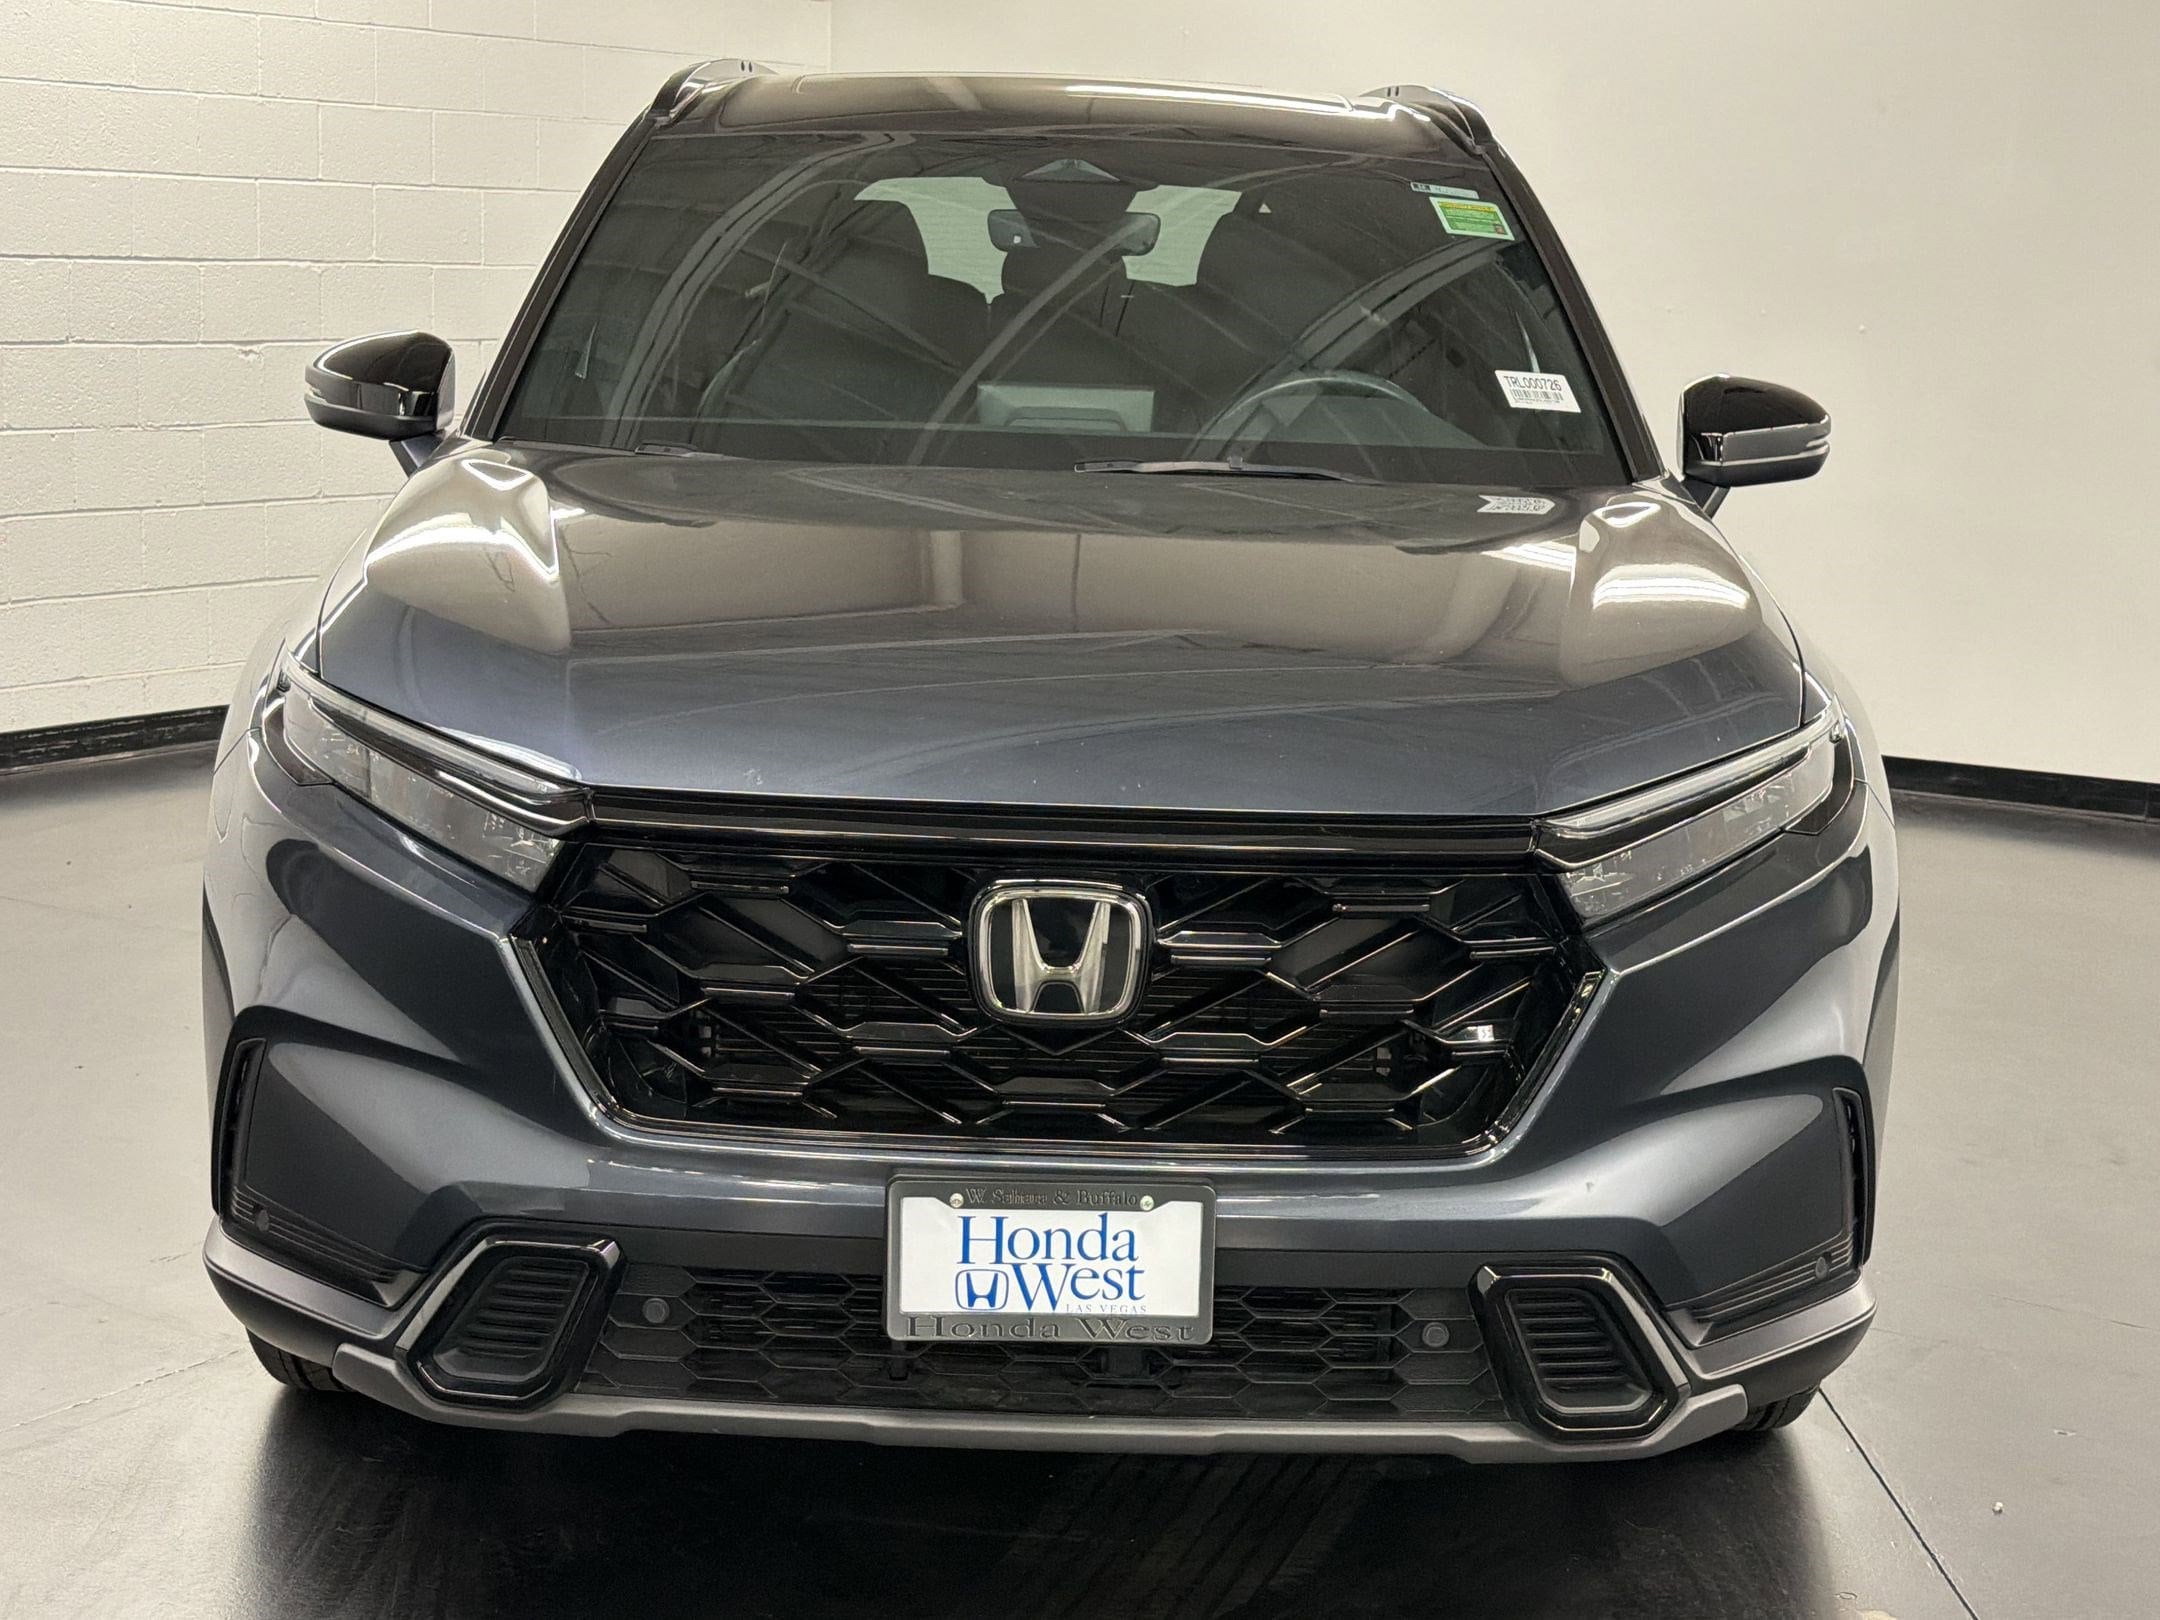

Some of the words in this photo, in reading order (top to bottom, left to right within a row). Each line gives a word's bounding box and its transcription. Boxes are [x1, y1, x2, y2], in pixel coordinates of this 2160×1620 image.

[1053, 1189, 1071, 1206] &
[957, 1212, 1138, 1264] Honda
[1012, 1262, 1145, 1312] West
[1066, 1303, 1093, 1313] LAS
[1099, 1303, 1147, 1314] VEGAS
[907, 1316, 1060, 1338] Honda
[1077, 1318, 1195, 1341] West
